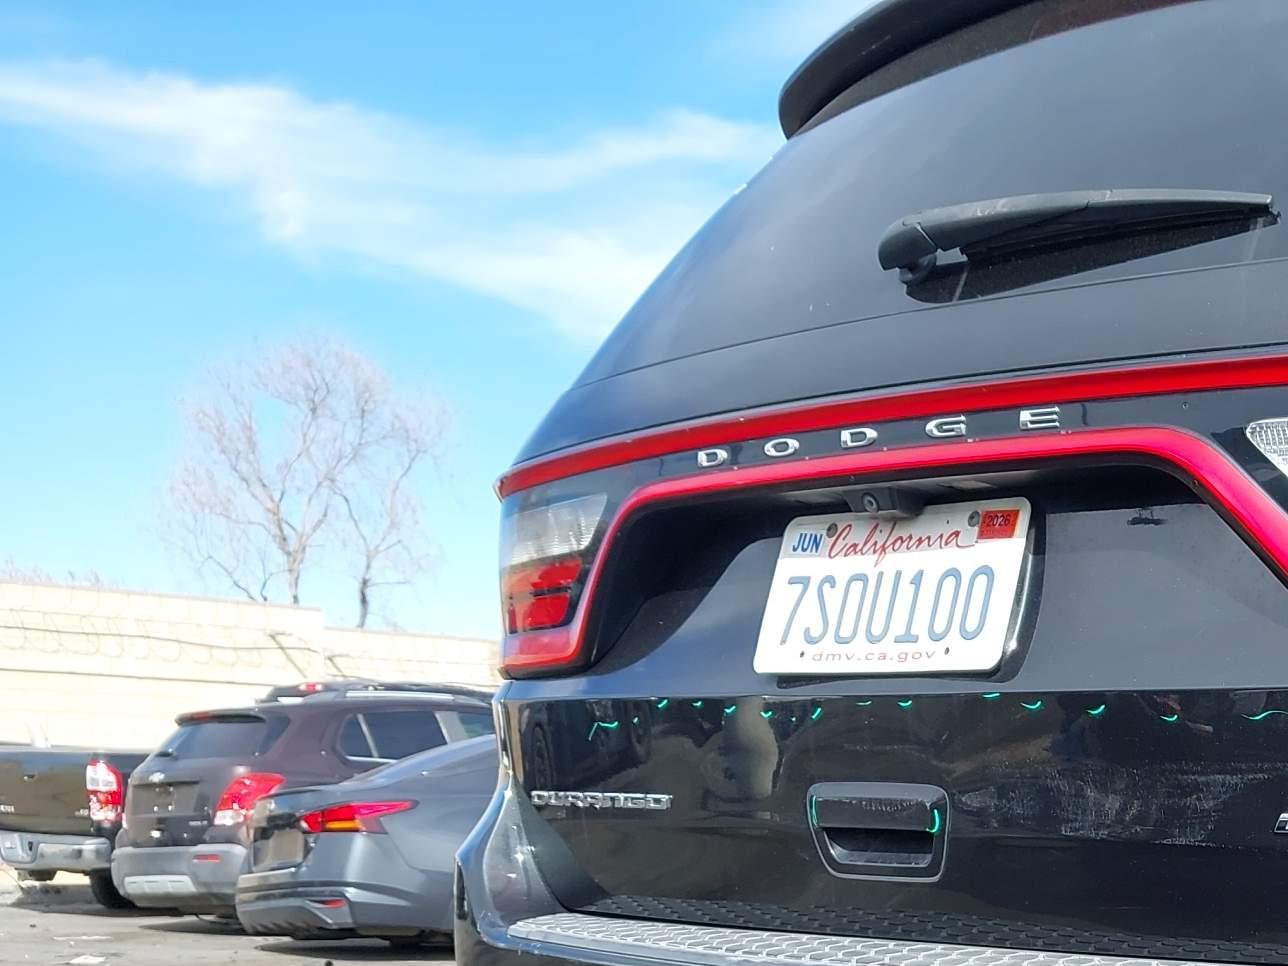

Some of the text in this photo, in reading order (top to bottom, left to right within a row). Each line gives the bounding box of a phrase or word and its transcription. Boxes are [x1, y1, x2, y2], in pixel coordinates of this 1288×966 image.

[697, 406, 1060, 467] DODGE
[987, 513, 1011, 527] 2026
[792, 532, 824, 554] JUN
[826, 522, 975, 567] California
[779, 564, 995, 646] 7SOU100
[811, 650, 936, 663] dmv.ca.gov
[531, 790, 673, 810] DURANGO
